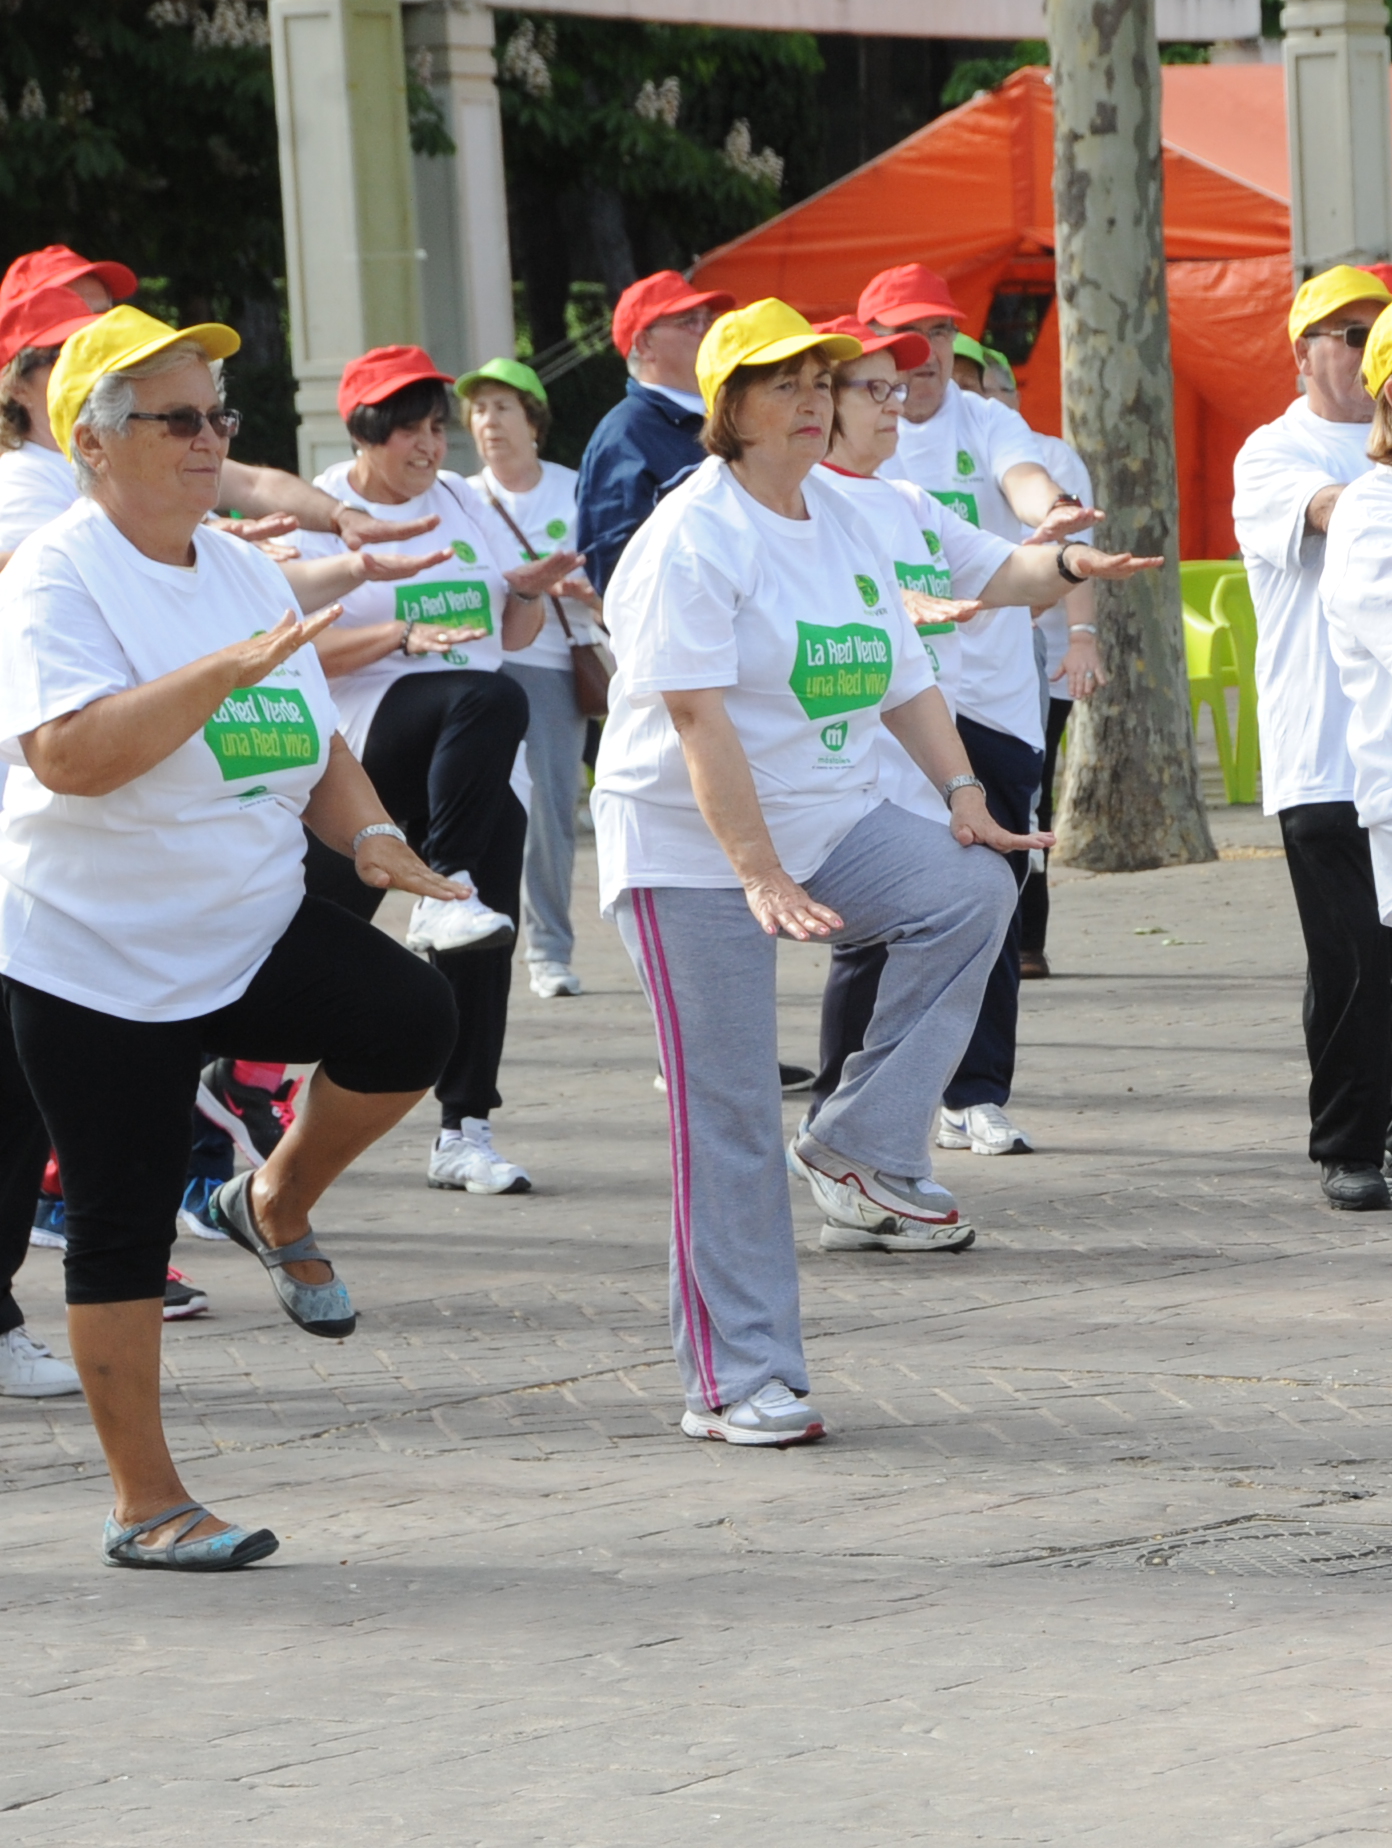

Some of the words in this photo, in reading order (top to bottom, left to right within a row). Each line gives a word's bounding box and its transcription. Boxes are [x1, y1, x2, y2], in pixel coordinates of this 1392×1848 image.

[403, 598, 421, 621] La
[420, 591, 448, 617] Red
[445, 586, 483, 612] Verde
[805, 639, 825, 667] La
[825, 635, 853, 665] Red
[853, 633, 888, 664] Verde
[806, 674, 834, 698] una
[837, 668, 862, 696] Red
[864, 666, 887, 695] viva
[224, 693, 261, 723] Red
[256, 693, 305, 723] Verde
[220, 732, 251, 757] una
[250, 726, 281, 757] Red
[282, 726, 311, 757] viva
